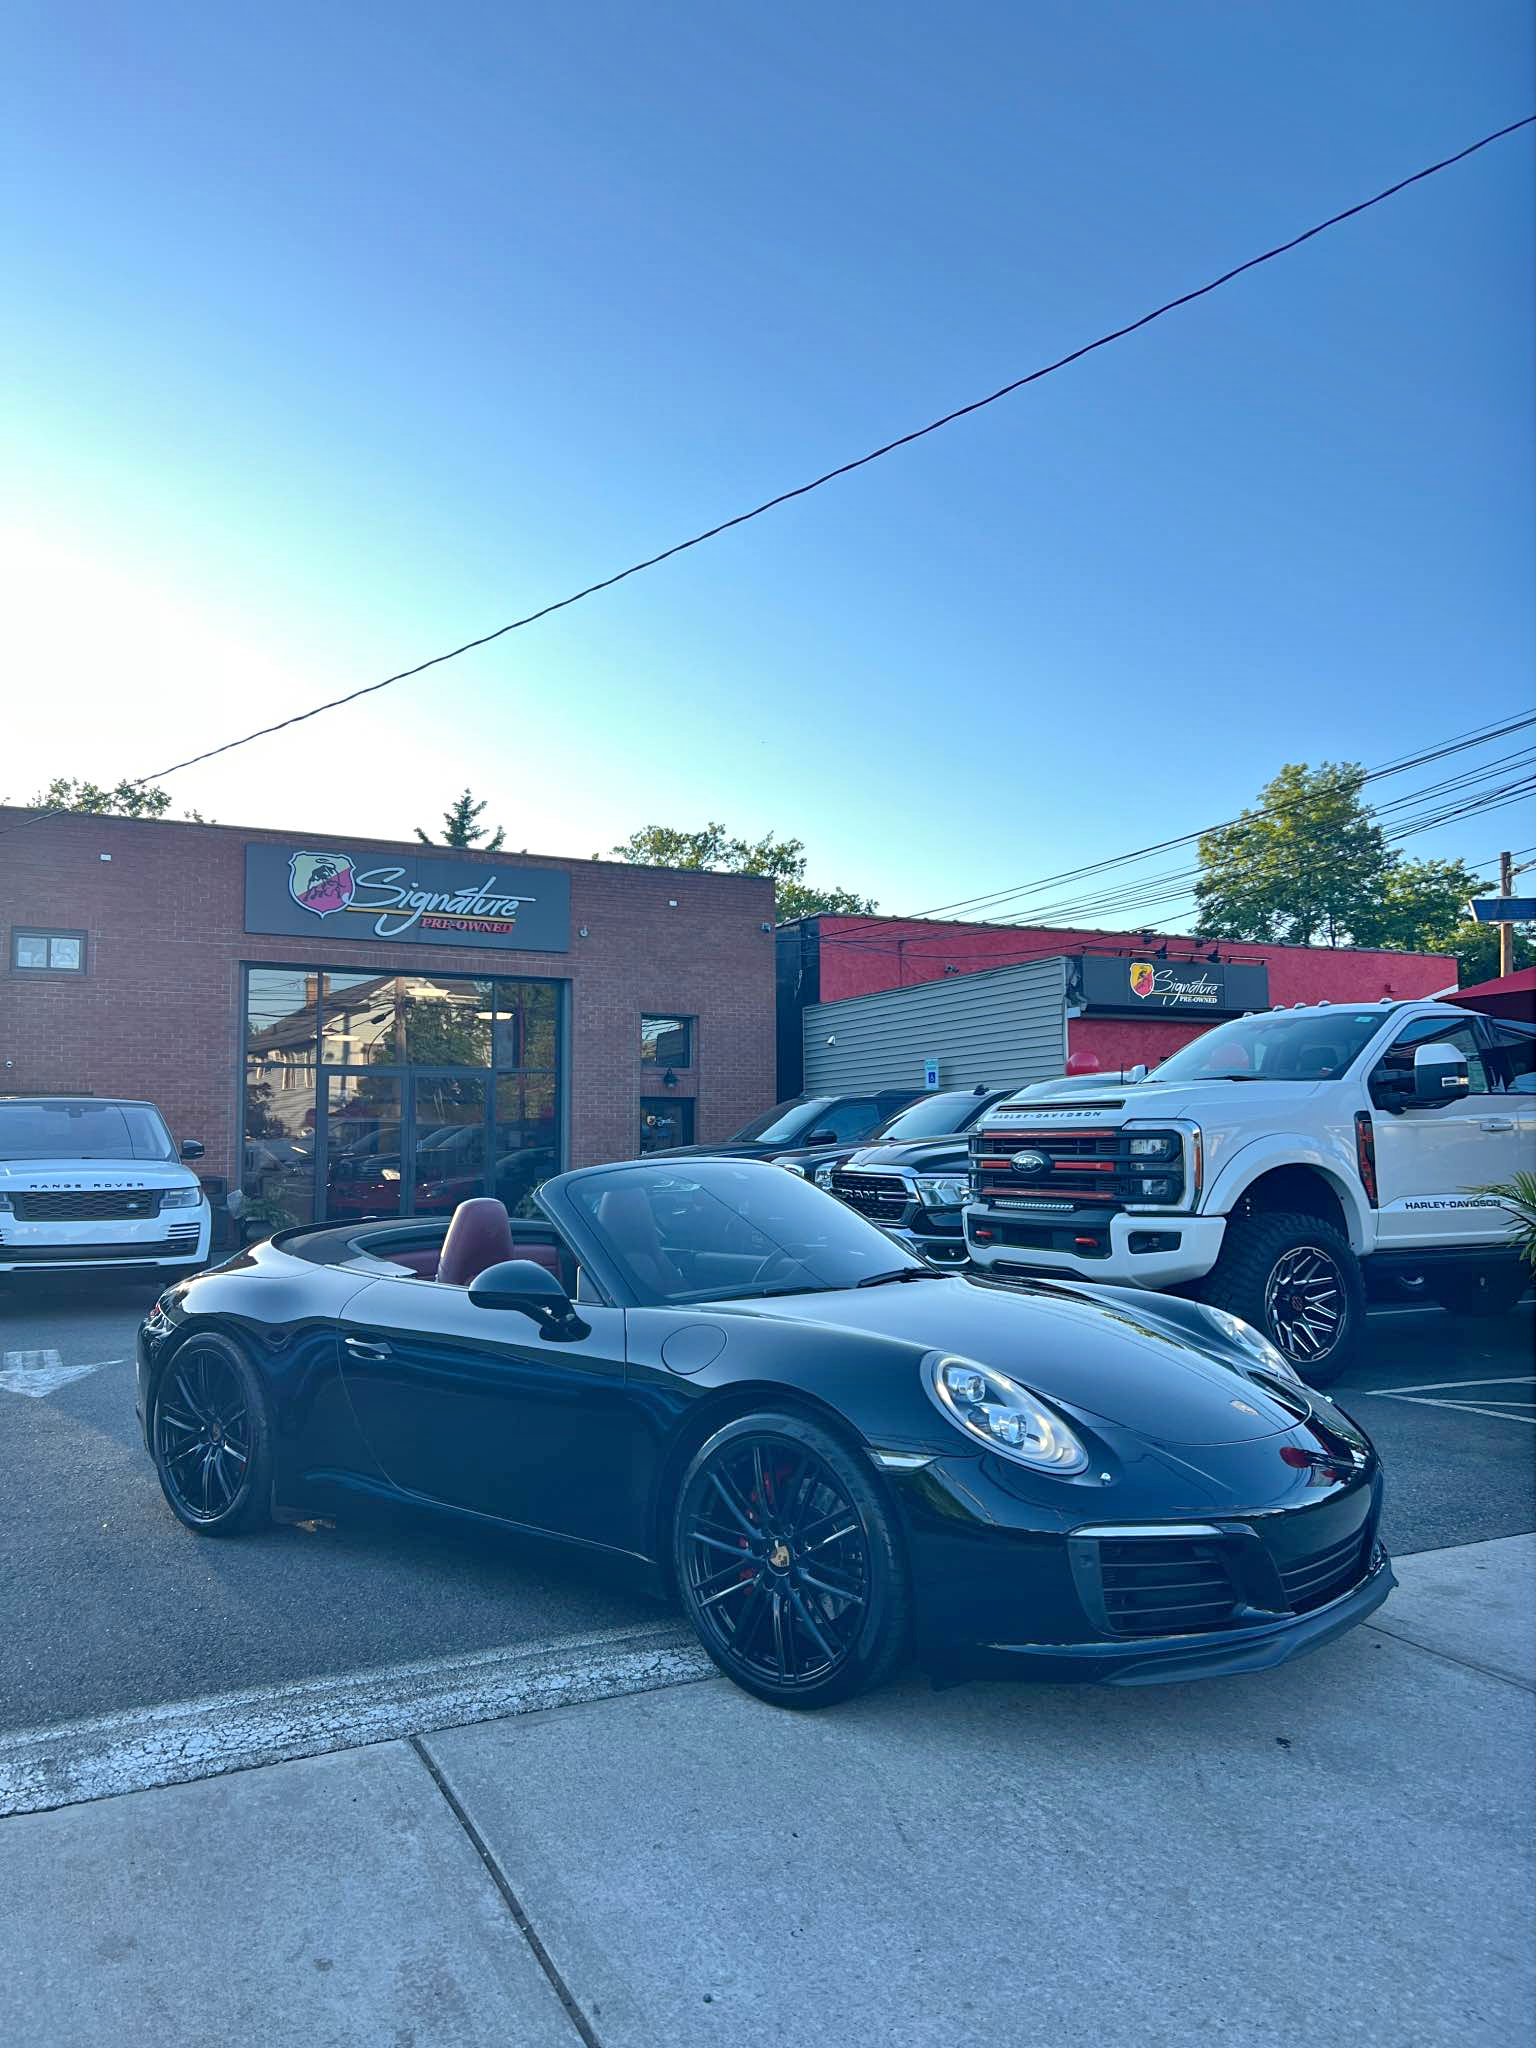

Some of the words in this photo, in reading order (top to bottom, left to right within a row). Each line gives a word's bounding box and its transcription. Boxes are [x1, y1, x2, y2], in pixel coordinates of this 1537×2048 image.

[343, 867, 536, 936] Signature
[421, 918, 513, 933] PRE-OWNED
[1150, 969, 1224, 1006] Signature
[1179, 996, 1218, 1004] PRE-OWNED
[1405, 1199, 1501, 1210] HARLEY-DAVIDSON
